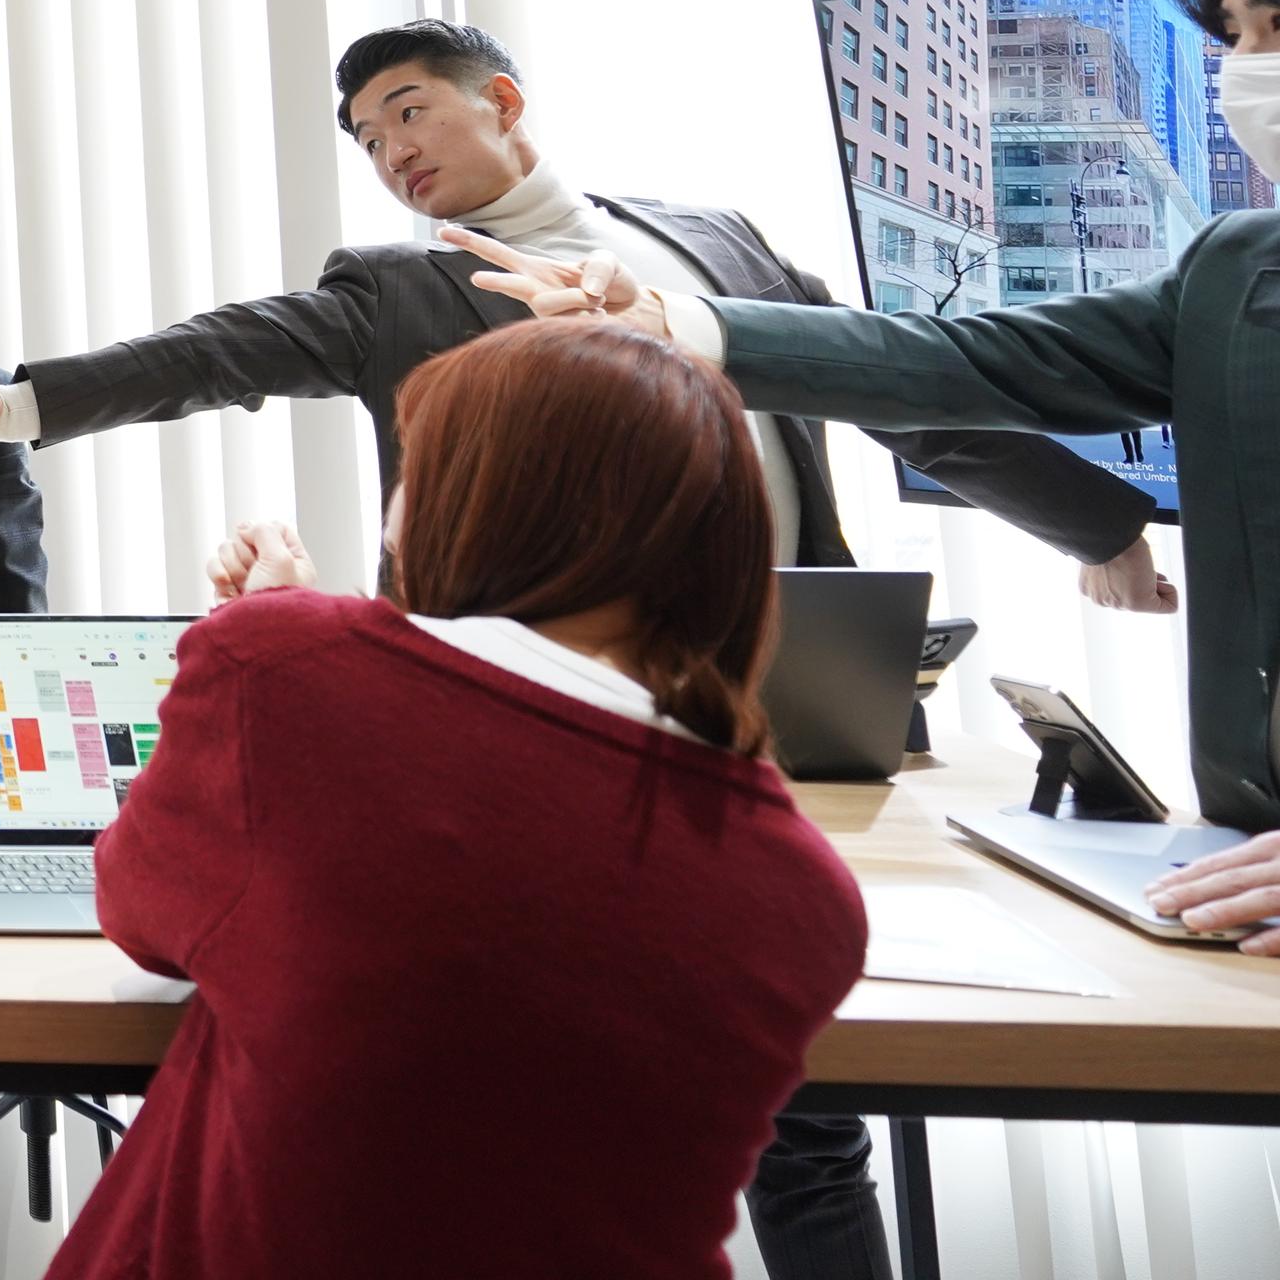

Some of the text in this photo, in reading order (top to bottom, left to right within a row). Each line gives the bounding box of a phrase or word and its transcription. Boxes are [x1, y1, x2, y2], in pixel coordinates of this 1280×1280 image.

[1103, 460, 1114, 470] by
[1117, 461, 1132, 470] the
[1135, 463, 1154, 472] End
